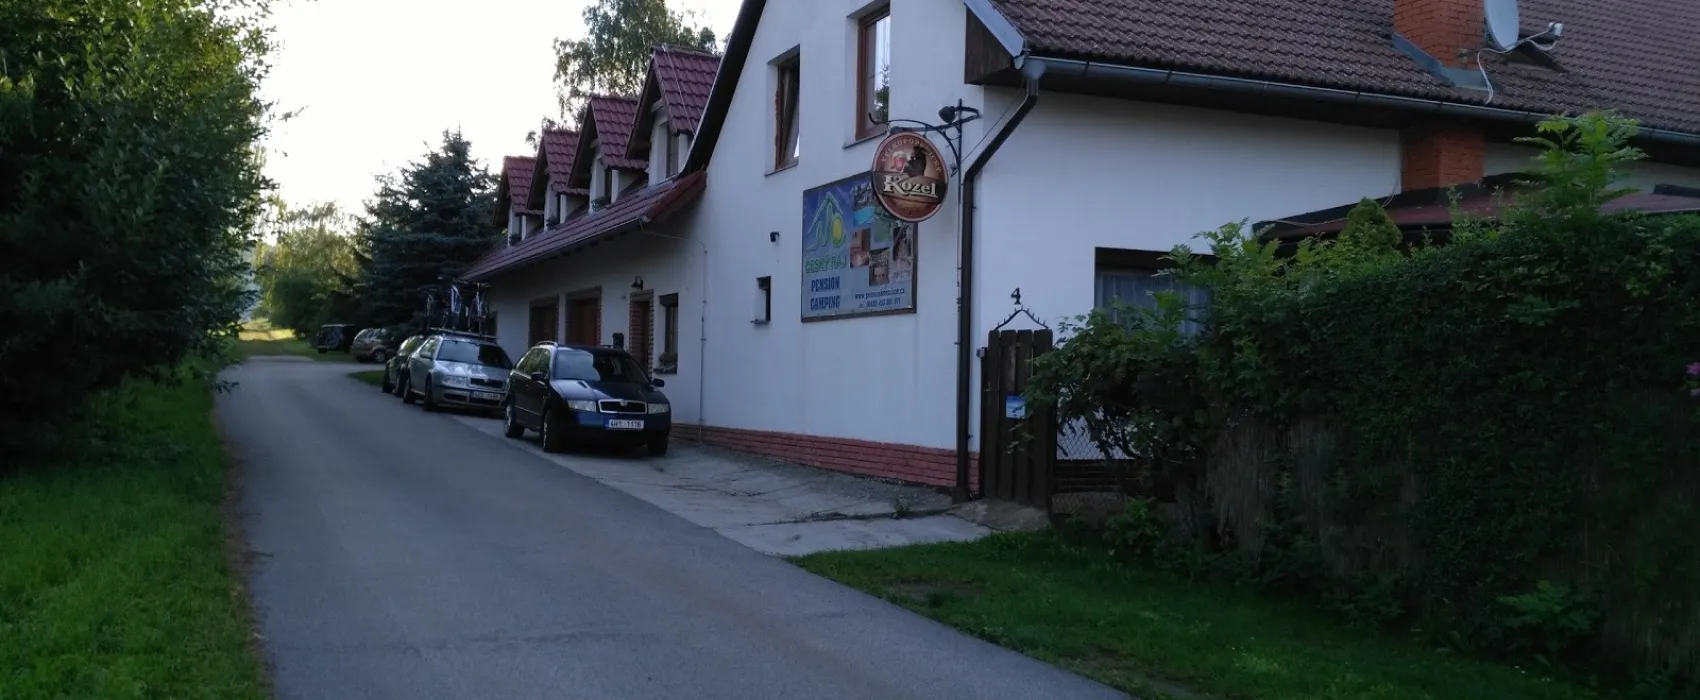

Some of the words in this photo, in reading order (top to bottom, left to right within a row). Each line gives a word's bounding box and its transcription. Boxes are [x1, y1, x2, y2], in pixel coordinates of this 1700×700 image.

[883, 175, 937, 196] Kozel
[811, 276, 840, 292] PENSION
[810, 295, 840, 311] CAMPING
[1011, 288, 1021, 305] 4
